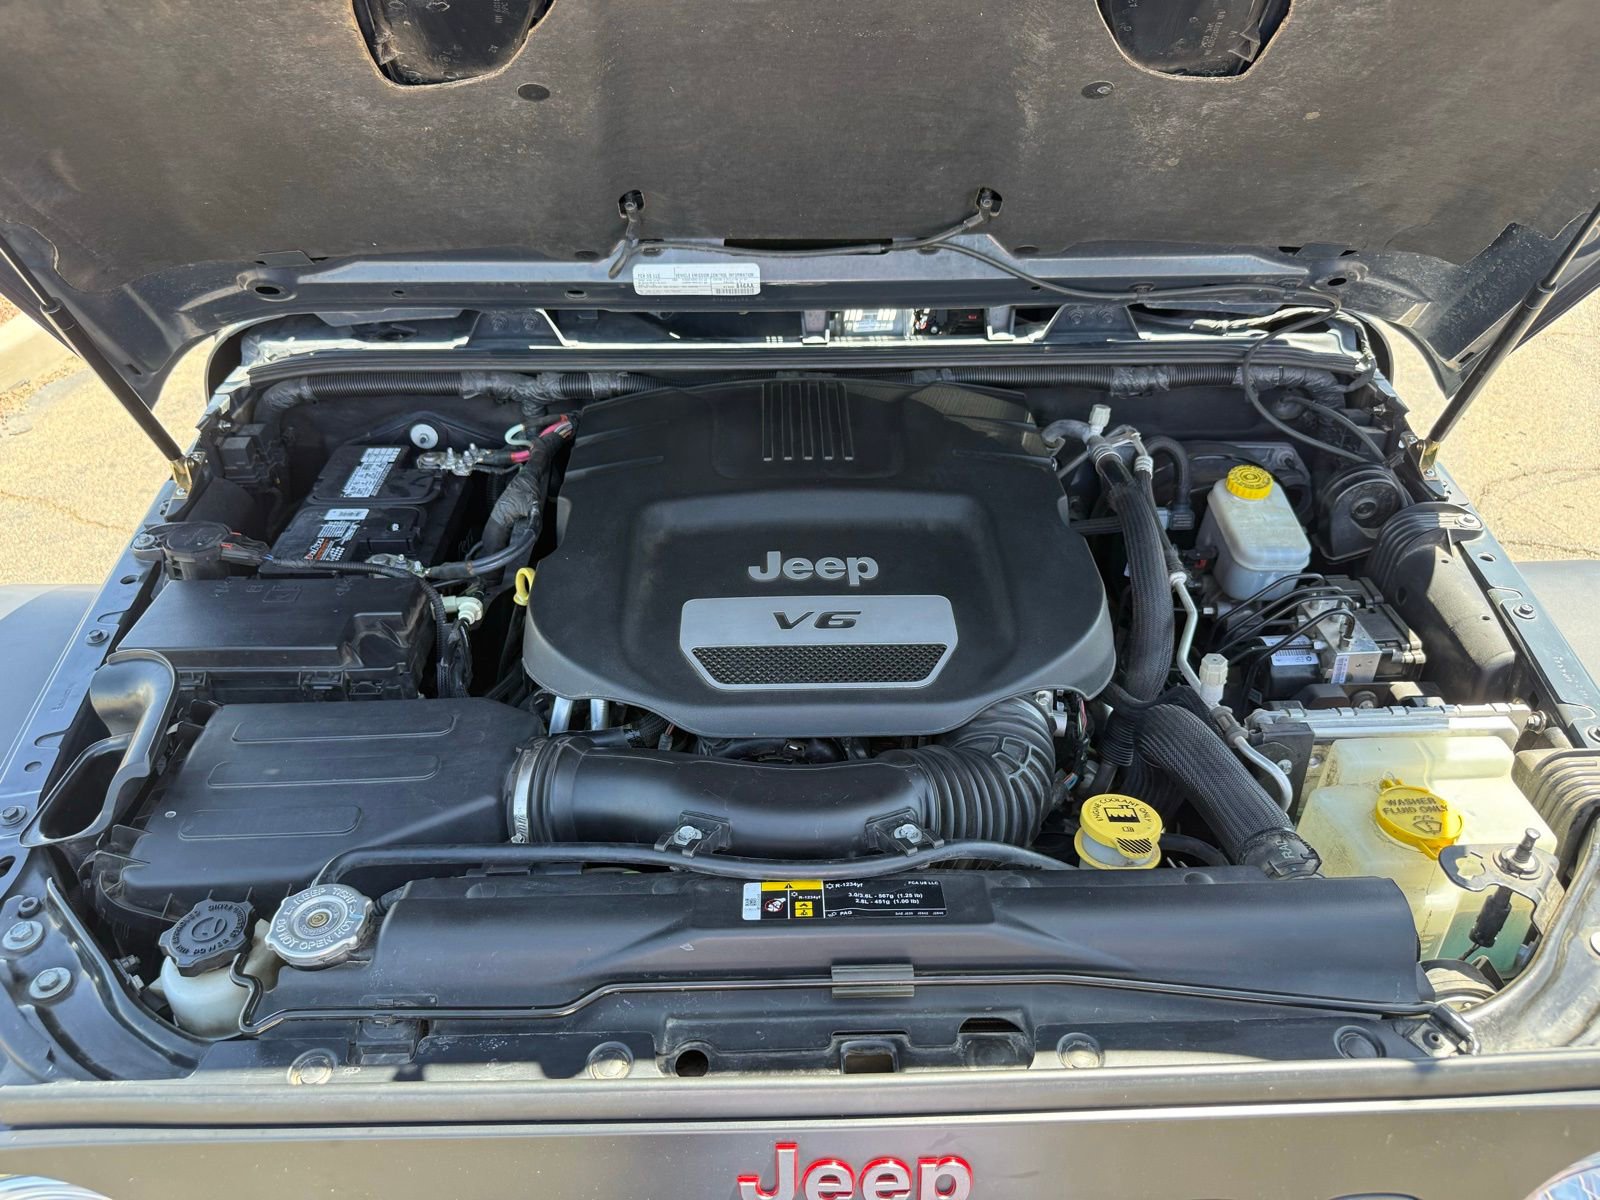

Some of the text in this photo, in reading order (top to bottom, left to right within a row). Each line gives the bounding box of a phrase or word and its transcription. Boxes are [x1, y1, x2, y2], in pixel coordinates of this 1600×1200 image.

[748, 550, 879, 586] Jeep
[773, 611, 862, 630] V6
[1100, 798, 1140, 808] COOLANT
[1382, 804, 1449, 815] FLUID ONLY
[1387, 797, 1437, 806] WASHER
[294, 887, 327, 905] KEEP
[276, 918, 287, 932] DO
[299, 935, 334, 950] OPEN
[334, 920, 355, 938] HOT
[737, 1142, 974, 1200] Jeep
